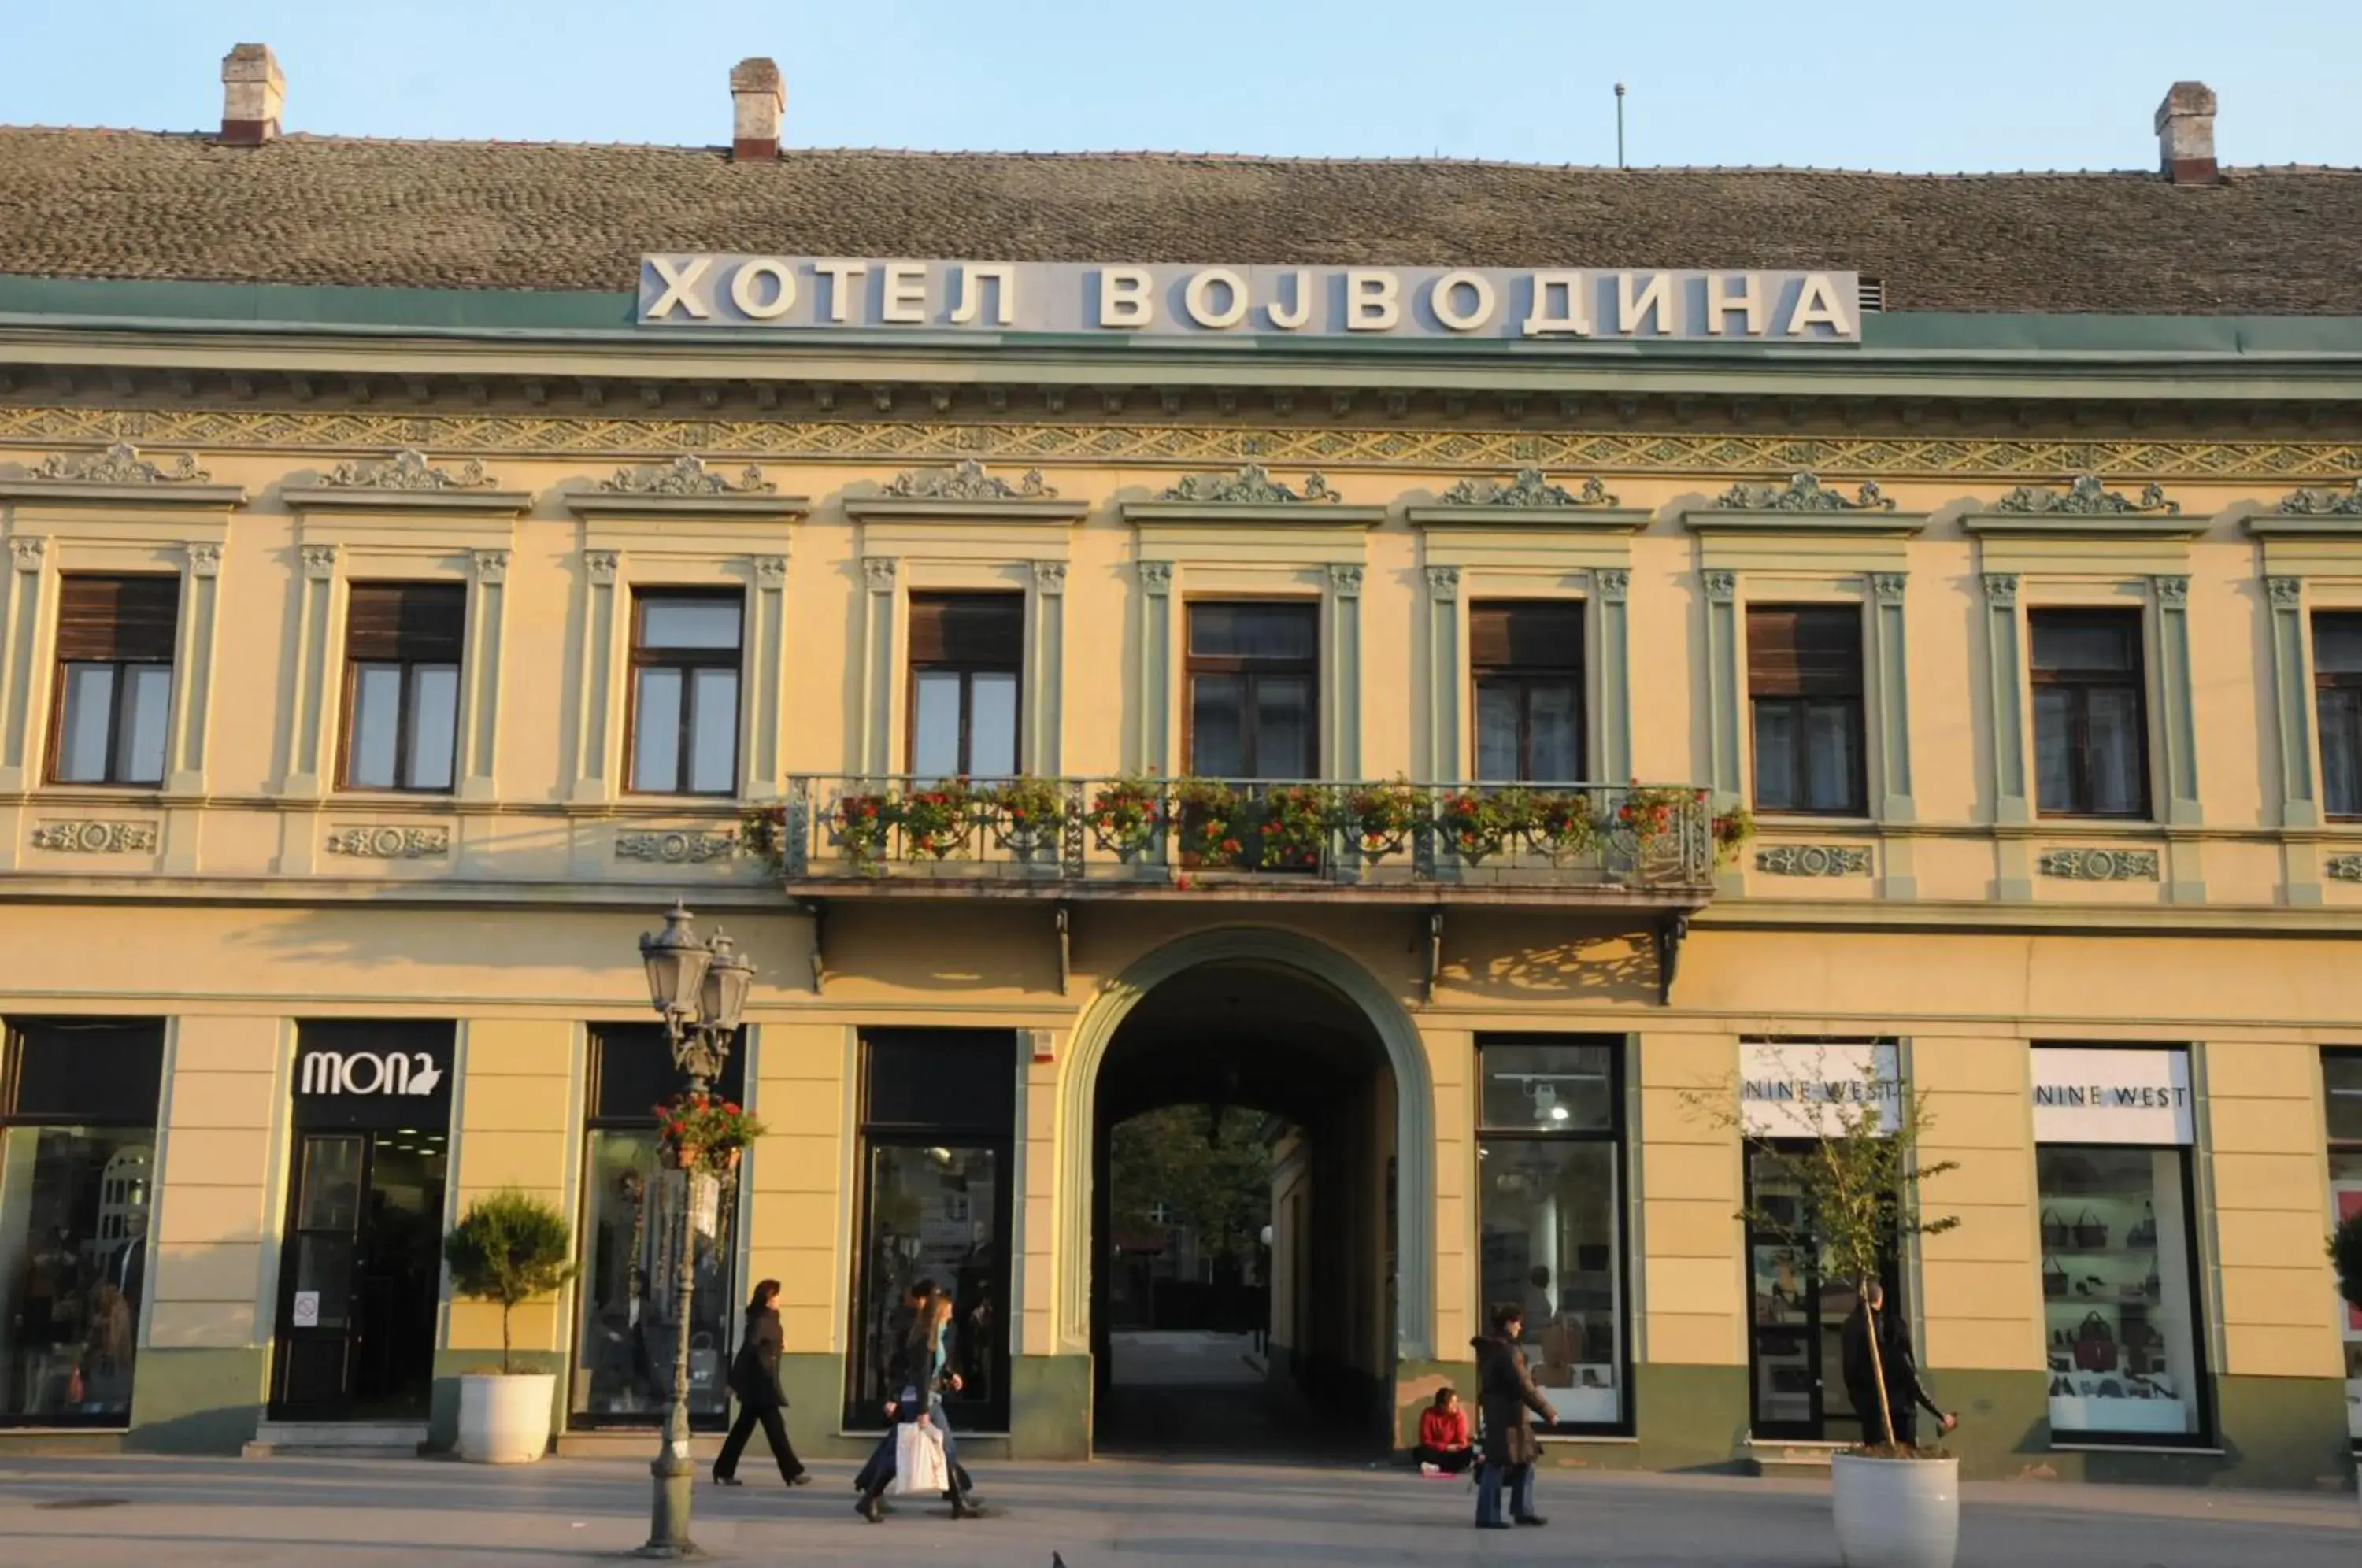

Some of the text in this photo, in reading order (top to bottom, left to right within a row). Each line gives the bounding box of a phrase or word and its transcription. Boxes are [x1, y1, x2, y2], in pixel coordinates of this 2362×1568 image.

[646, 257, 1852, 337] ХОТЕЛ ВОЈВОДИНА
[1746, 1079, 1899, 1103] NINE WEST
[2035, 1085, 2187, 1108] NINE WEST
